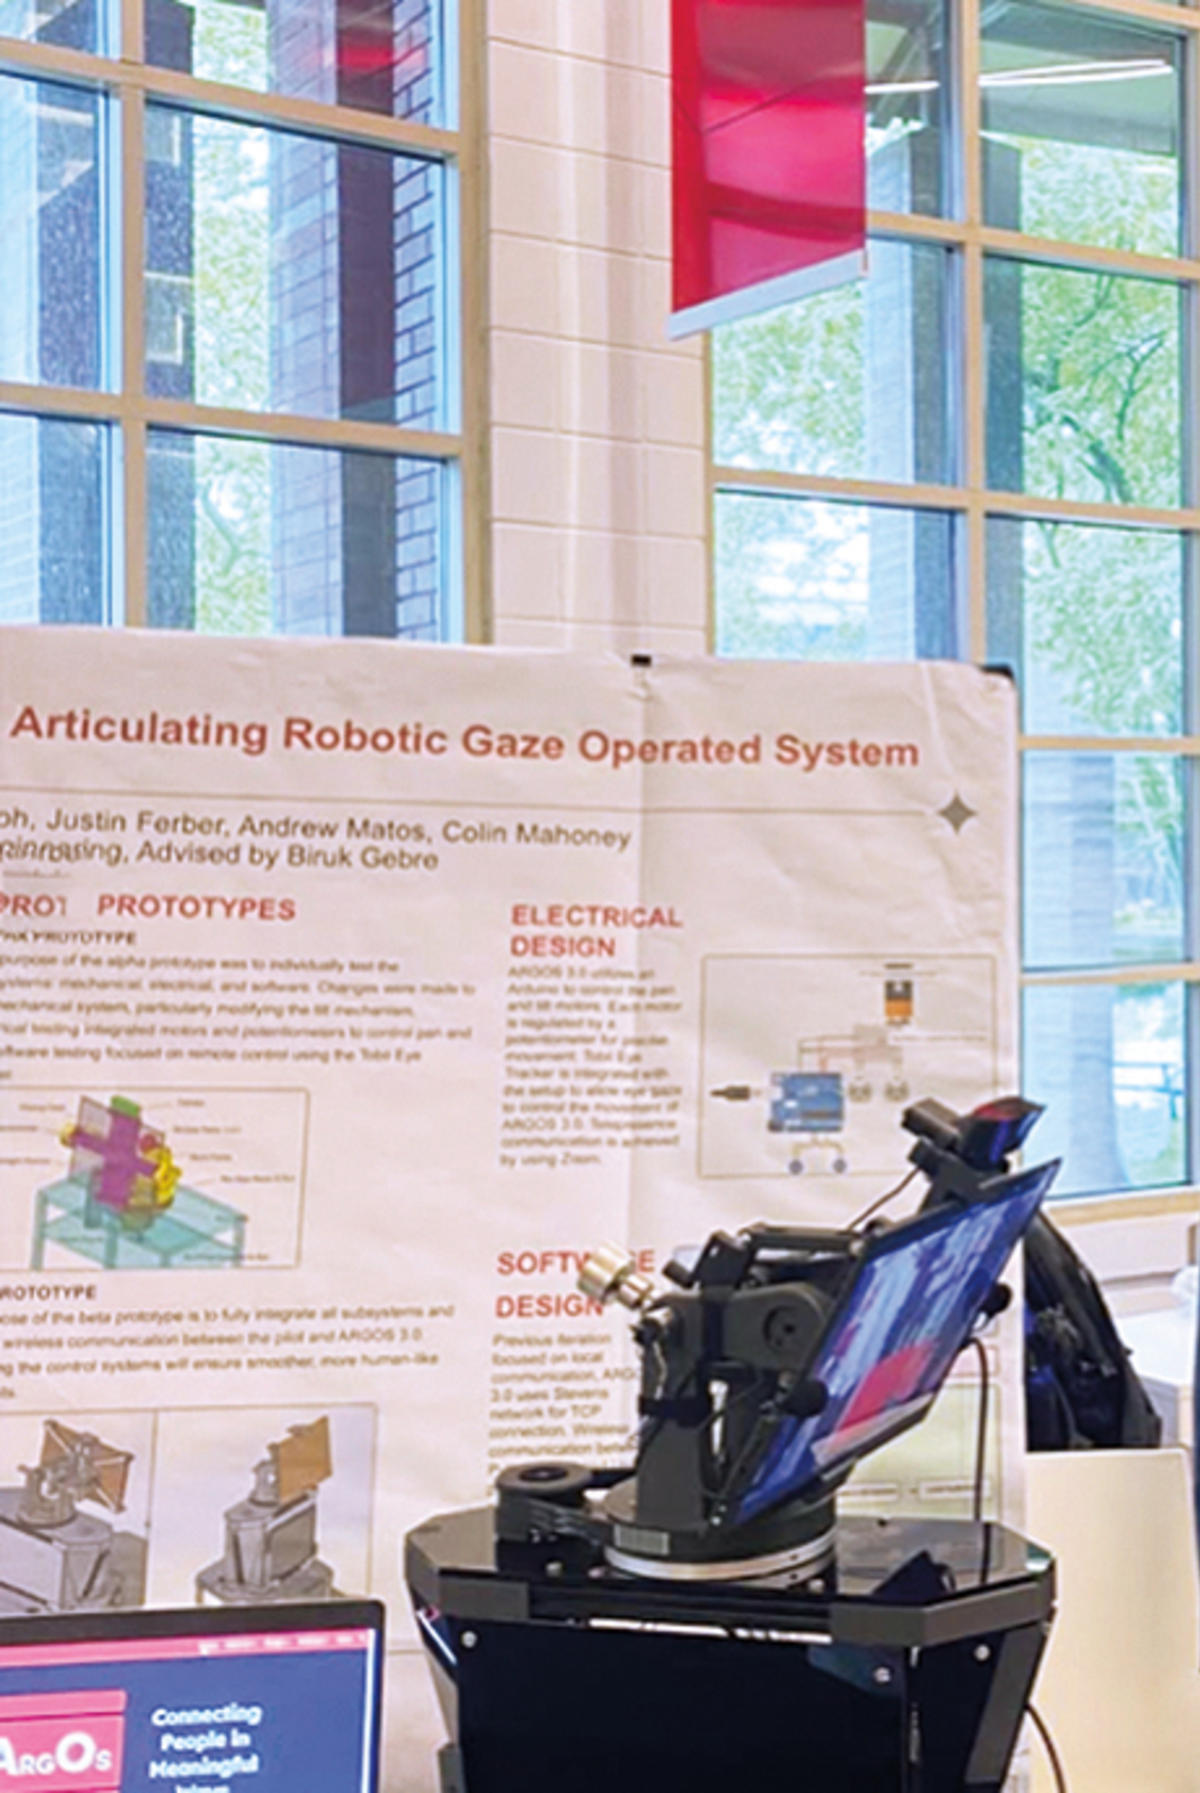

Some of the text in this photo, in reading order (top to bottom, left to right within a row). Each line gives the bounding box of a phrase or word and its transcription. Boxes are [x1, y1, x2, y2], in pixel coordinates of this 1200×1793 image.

[10, 705, 920, 772] Articulating Robotic Gaze Operated System
[46, 807, 127, 833] Justin
[136, 810, 230, 838] Ferber,
[238, 814, 339, 841] Andrew
[346, 816, 433, 846] Matos,
[442, 819, 507, 844] Colin
[515, 821, 633, 851] Mahoney
[136, 839, 242, 865] Advised
[249, 843, 280, 871] by
[287, 846, 352, 868] Biruk
[360, 848, 439, 872] Gebre
[97, 893, 297, 922] PROTOTYPES
[511, 905, 684, 930] ELECTRICAL
[510, 935, 617, 958] DESIGN
[495, 1293, 604, 1318] DESIGN
[151, 1702, 264, 1727] Connecting
[160, 1727, 251, 1753] People in
[148, 1753, 260, 1779] Meaningful
